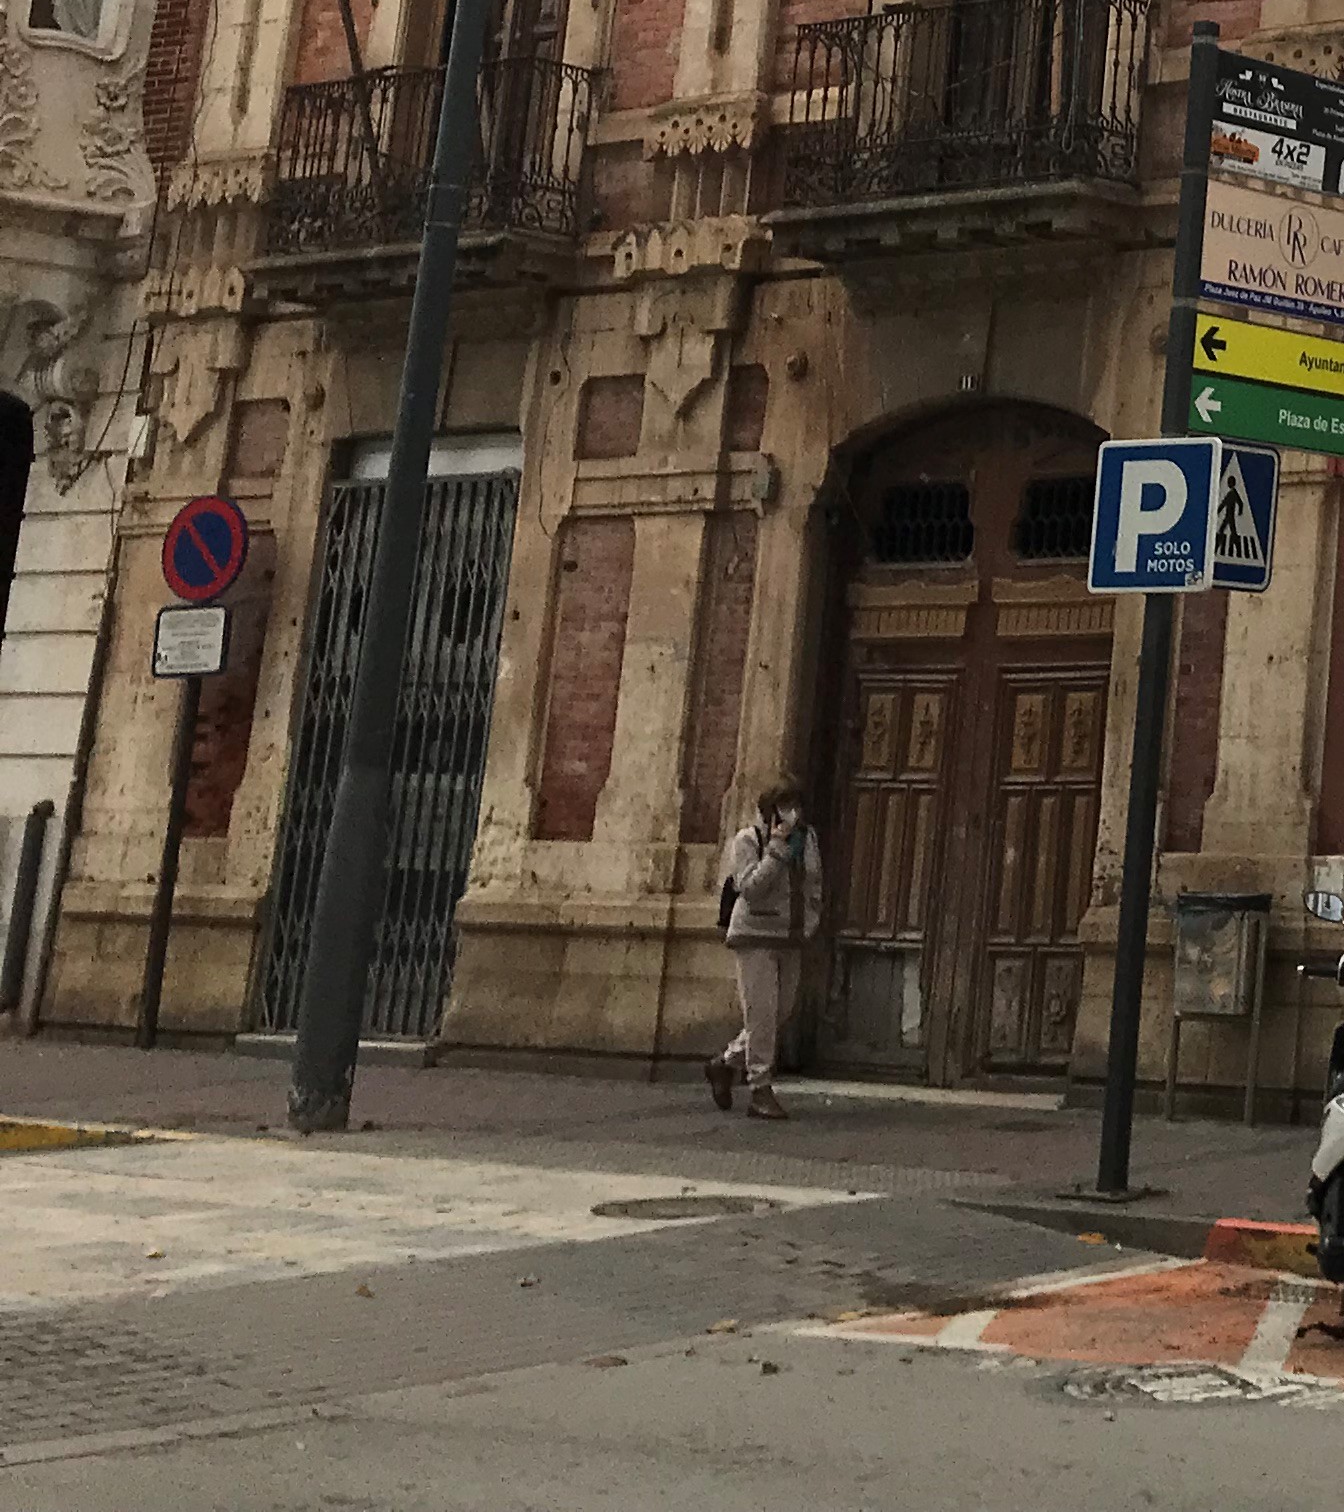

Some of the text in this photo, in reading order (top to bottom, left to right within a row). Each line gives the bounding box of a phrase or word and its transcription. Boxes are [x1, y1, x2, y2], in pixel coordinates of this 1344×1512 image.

[1271, 137, 1312, 166] 4x2
[1211, 210, 1275, 242] DULCERÍA
[1227, 259, 1288, 291] RAMÓN
[1278, 408, 1311, 429] Plaza
[1313, 414, 1329, 432] de
[1114, 459, 1188, 573] P
[1154, 541, 1191, 556] SOLO
[1147, 558, 1195, 573] MOTOS
